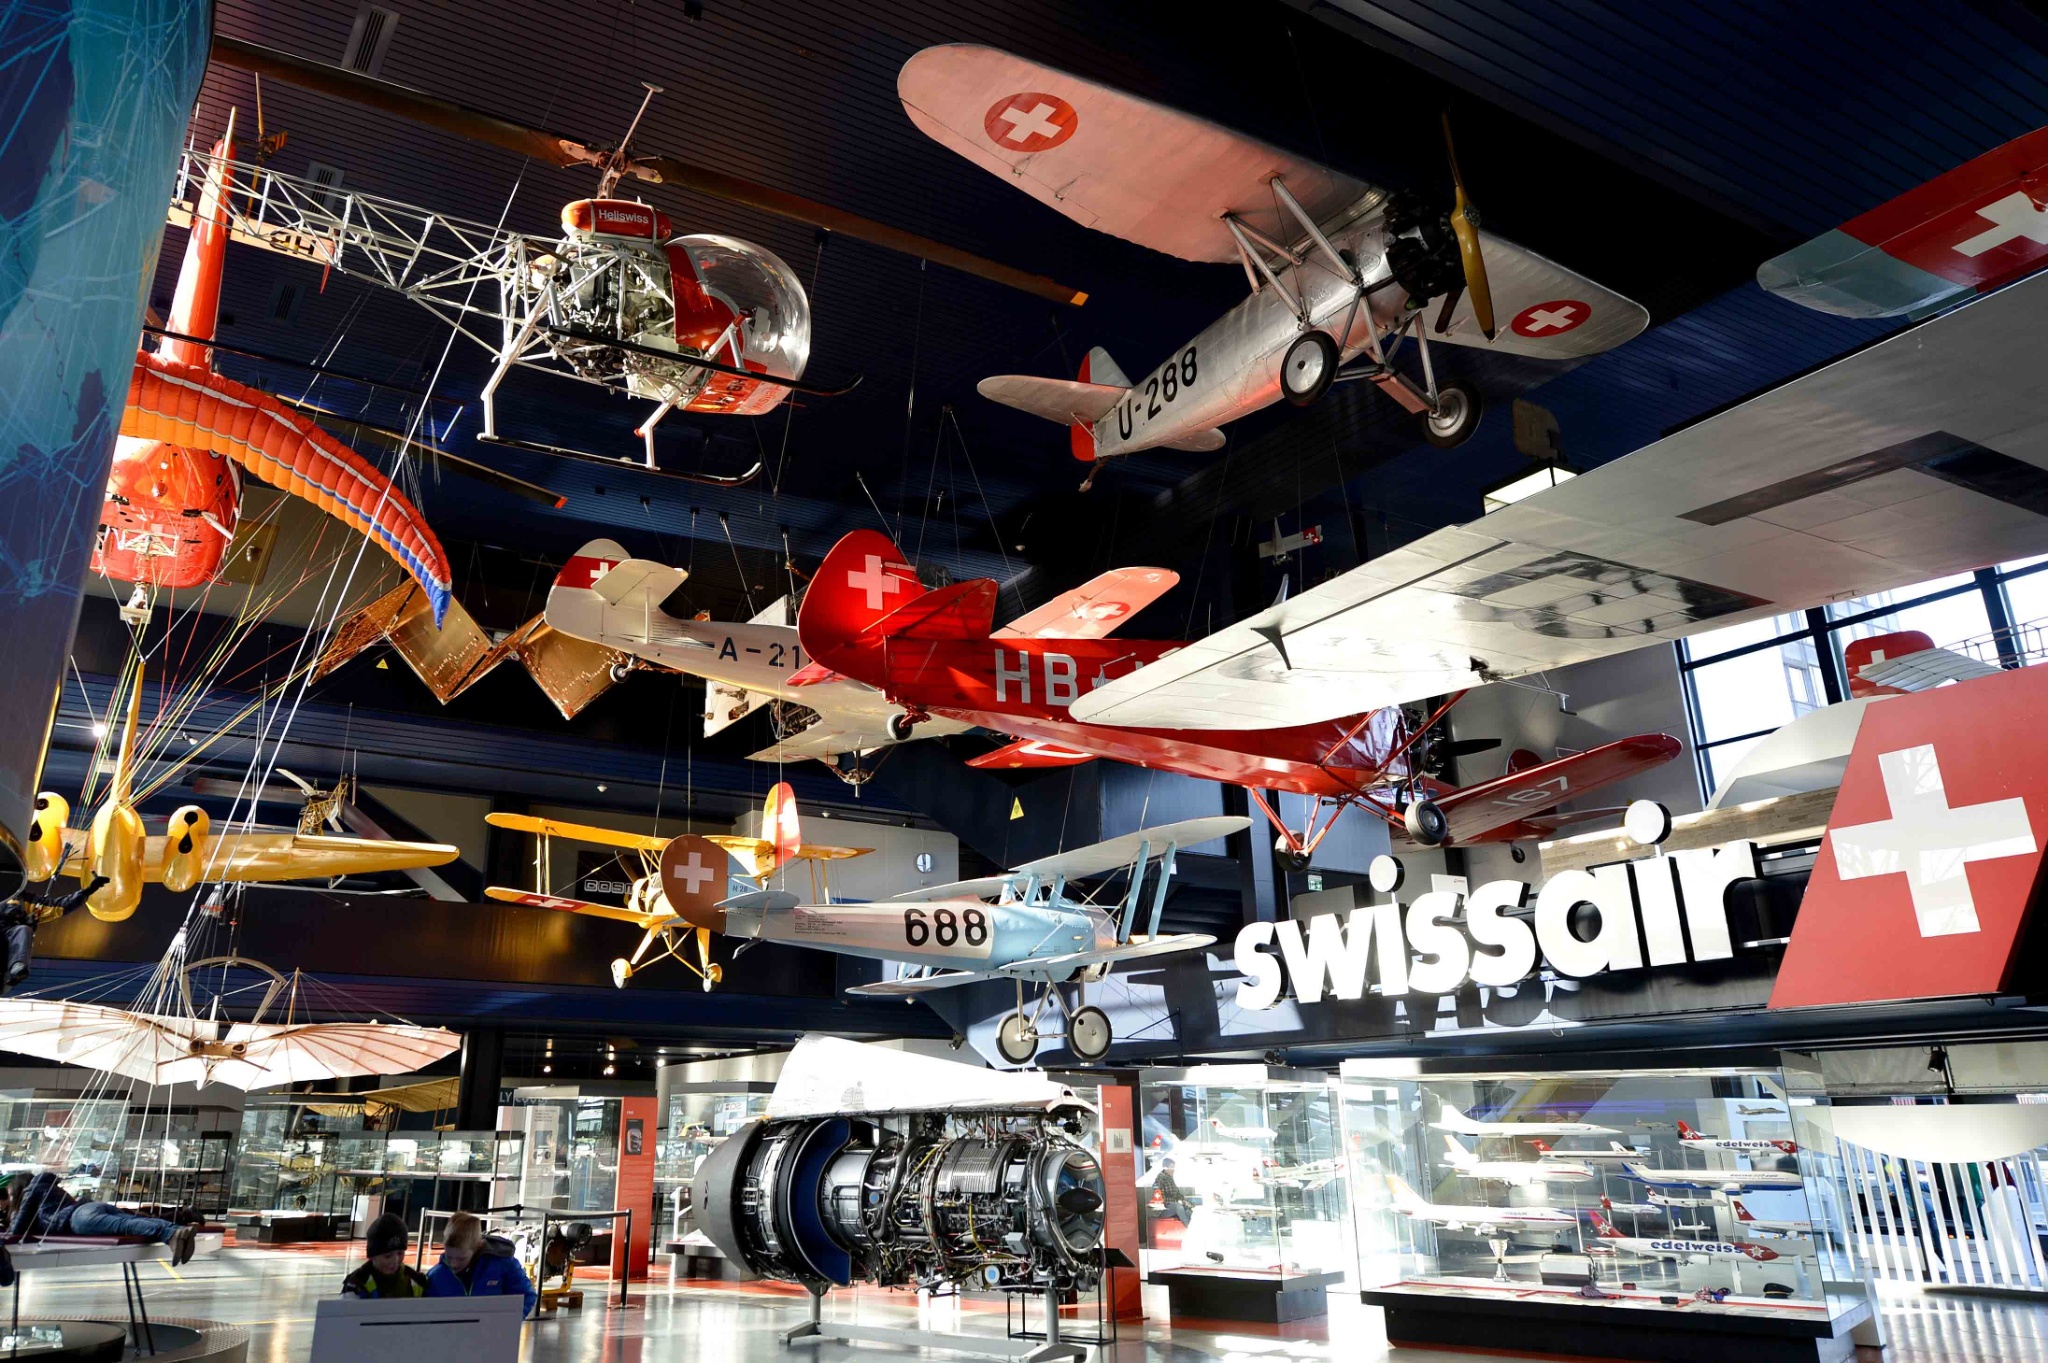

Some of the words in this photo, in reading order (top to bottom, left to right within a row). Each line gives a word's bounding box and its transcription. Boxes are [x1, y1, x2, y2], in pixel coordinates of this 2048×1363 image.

[598, 209, 649, 224] Heliswiss
[1118, 346, 1198, 441] U-288
[718, 636, 812, 670] A-21
[994, 648, 1144, 707] HB-
[1491, 775, 1569, 807] 167
[1234, 799, 1764, 1011] swissair
[903, 908, 988, 947] 688
[499, 1091, 513, 1103] LY
[1650, 1240, 1744, 1254] edelweiss
